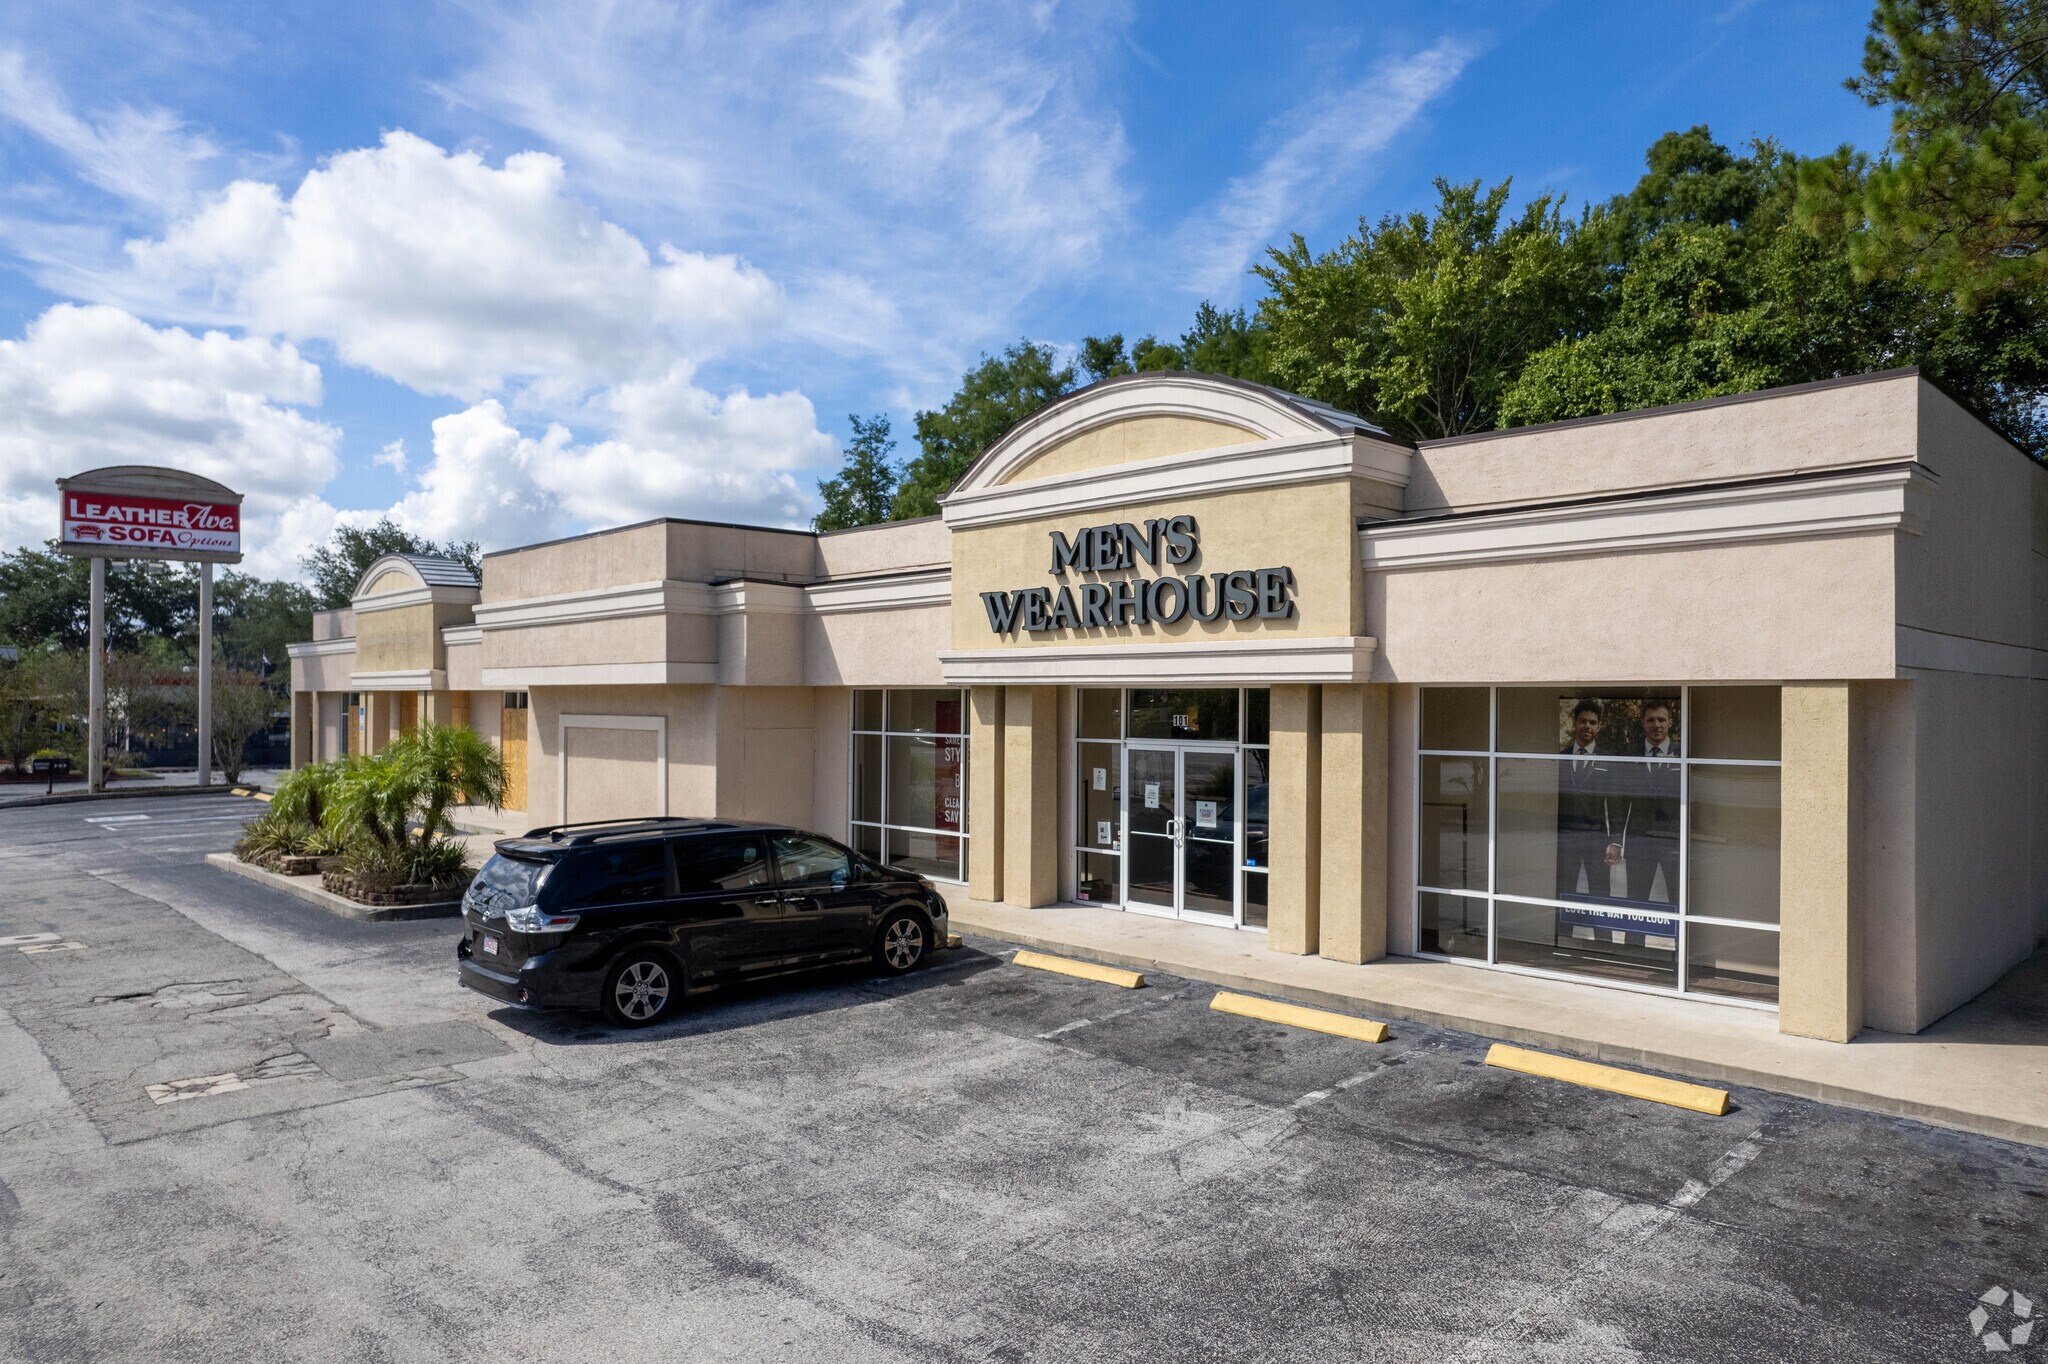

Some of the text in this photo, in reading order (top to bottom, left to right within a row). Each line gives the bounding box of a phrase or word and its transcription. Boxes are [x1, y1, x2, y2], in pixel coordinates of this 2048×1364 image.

[70, 499, 191, 528] LEATHER
[108, 526, 232, 548] SOFA Options
[1048, 515, 1196, 575] MEN'S
[979, 565, 1294, 634] WEARHOUSE
[1174, 716, 1187, 726] 101
